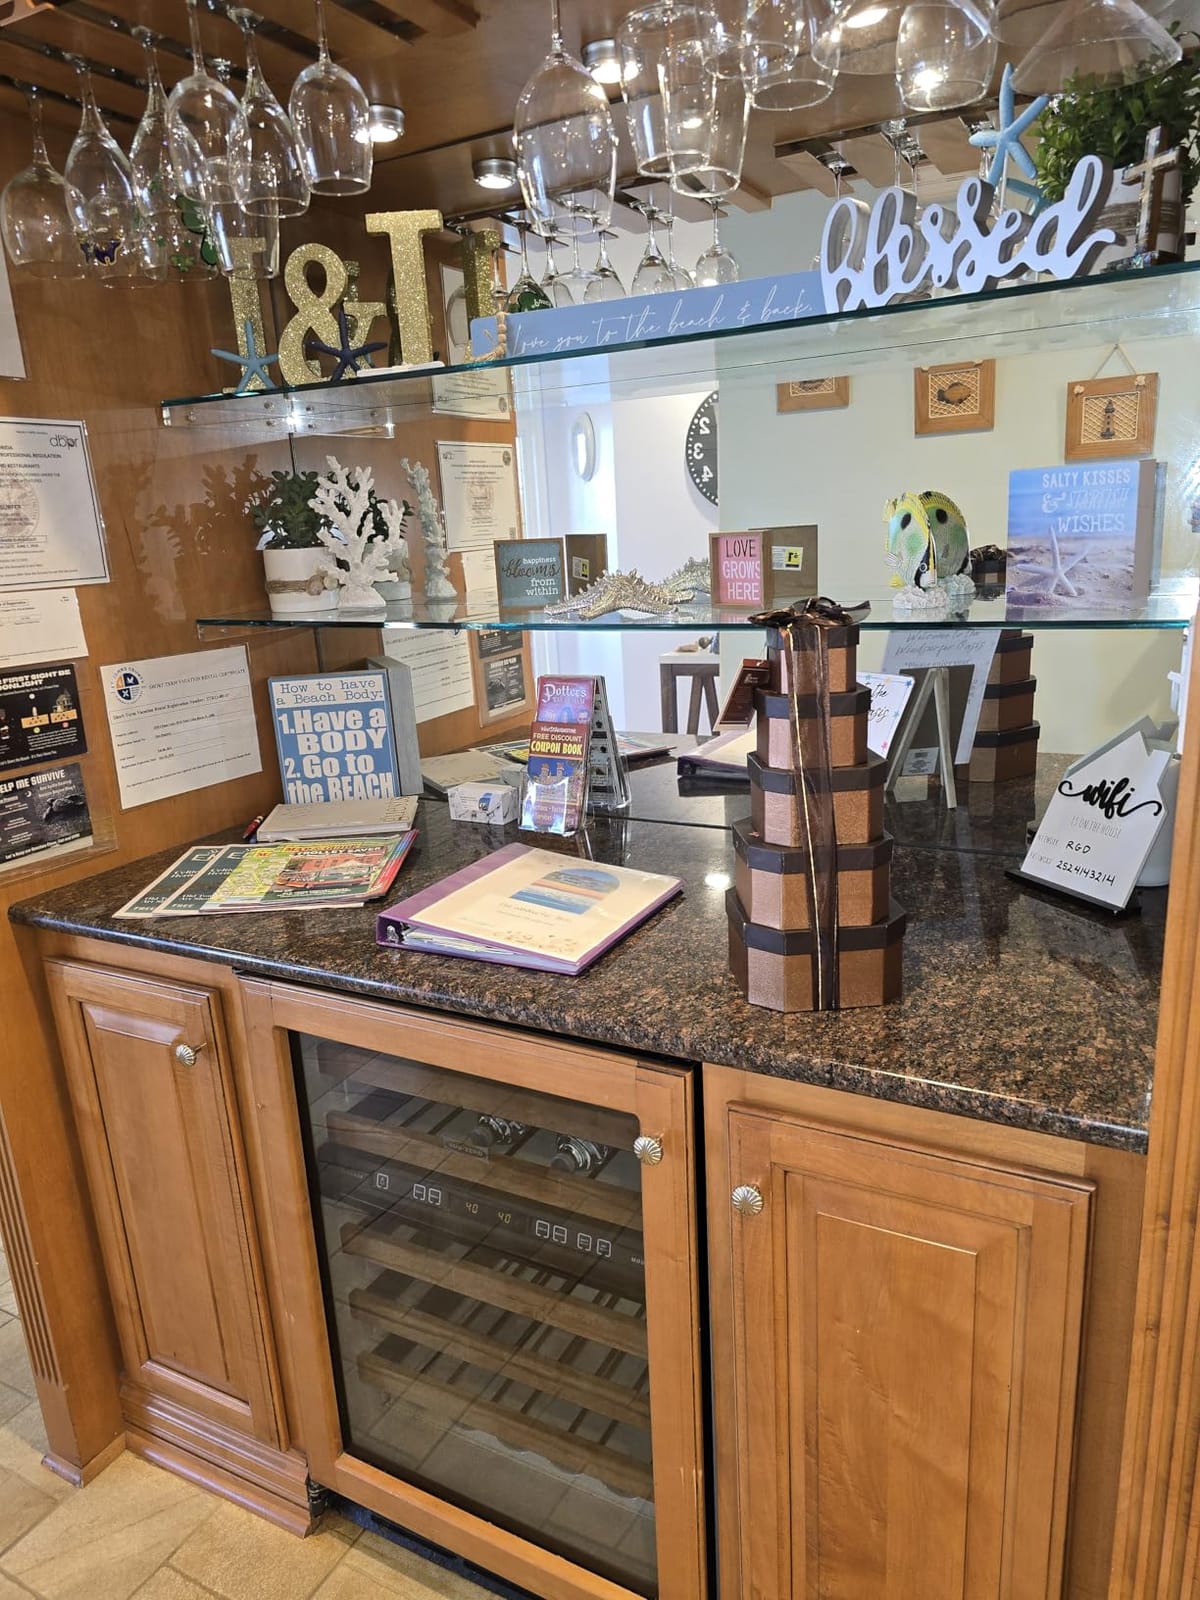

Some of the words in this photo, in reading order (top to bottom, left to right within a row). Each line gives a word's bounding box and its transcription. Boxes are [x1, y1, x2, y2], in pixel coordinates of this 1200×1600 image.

[820, 155, 1115, 314] blessed
[668, 294, 725, 335] beach
[1042, 471, 1079, 488] SALTY
[1083, 468, 1131, 487] KISSES
[1058, 513, 1125, 533] WISHES
[726, 539, 756, 558] LOVE
[523, 556, 556, 566] happiness
[723, 560, 760, 579] GROWS
[526, 586, 559, 596] within
[531, 577, 556, 587] from
[727, 582, 760, 600] HERE
[276, 697, 285, 705] a
[293, 692, 336, 705] Beach
[344, 688, 383, 701] Body:
[279, 683, 308, 694] How
[317, 681, 332, 690] to
[340, 680, 376, 690] have
[369, 708, 386, 728] a
[297, 727, 387, 755] BODY
[533, 732, 550, 740] FREE
[551, 734, 582, 742] DISCOUNT
[531, 740, 561, 753] COUPON
[563, 743, 583, 755] BOOK
[302, 754, 341, 779] Go
[345, 753, 375, 774] to
[0, 782, 14, 794] ELP
[16, 778, 30, 789] ME
[31, 769, 65, 786] SURVIVE
[288, 780, 324, 804] the
[327, 772, 394, 802] BEACH
[1058, 777, 1163, 819] wifi
